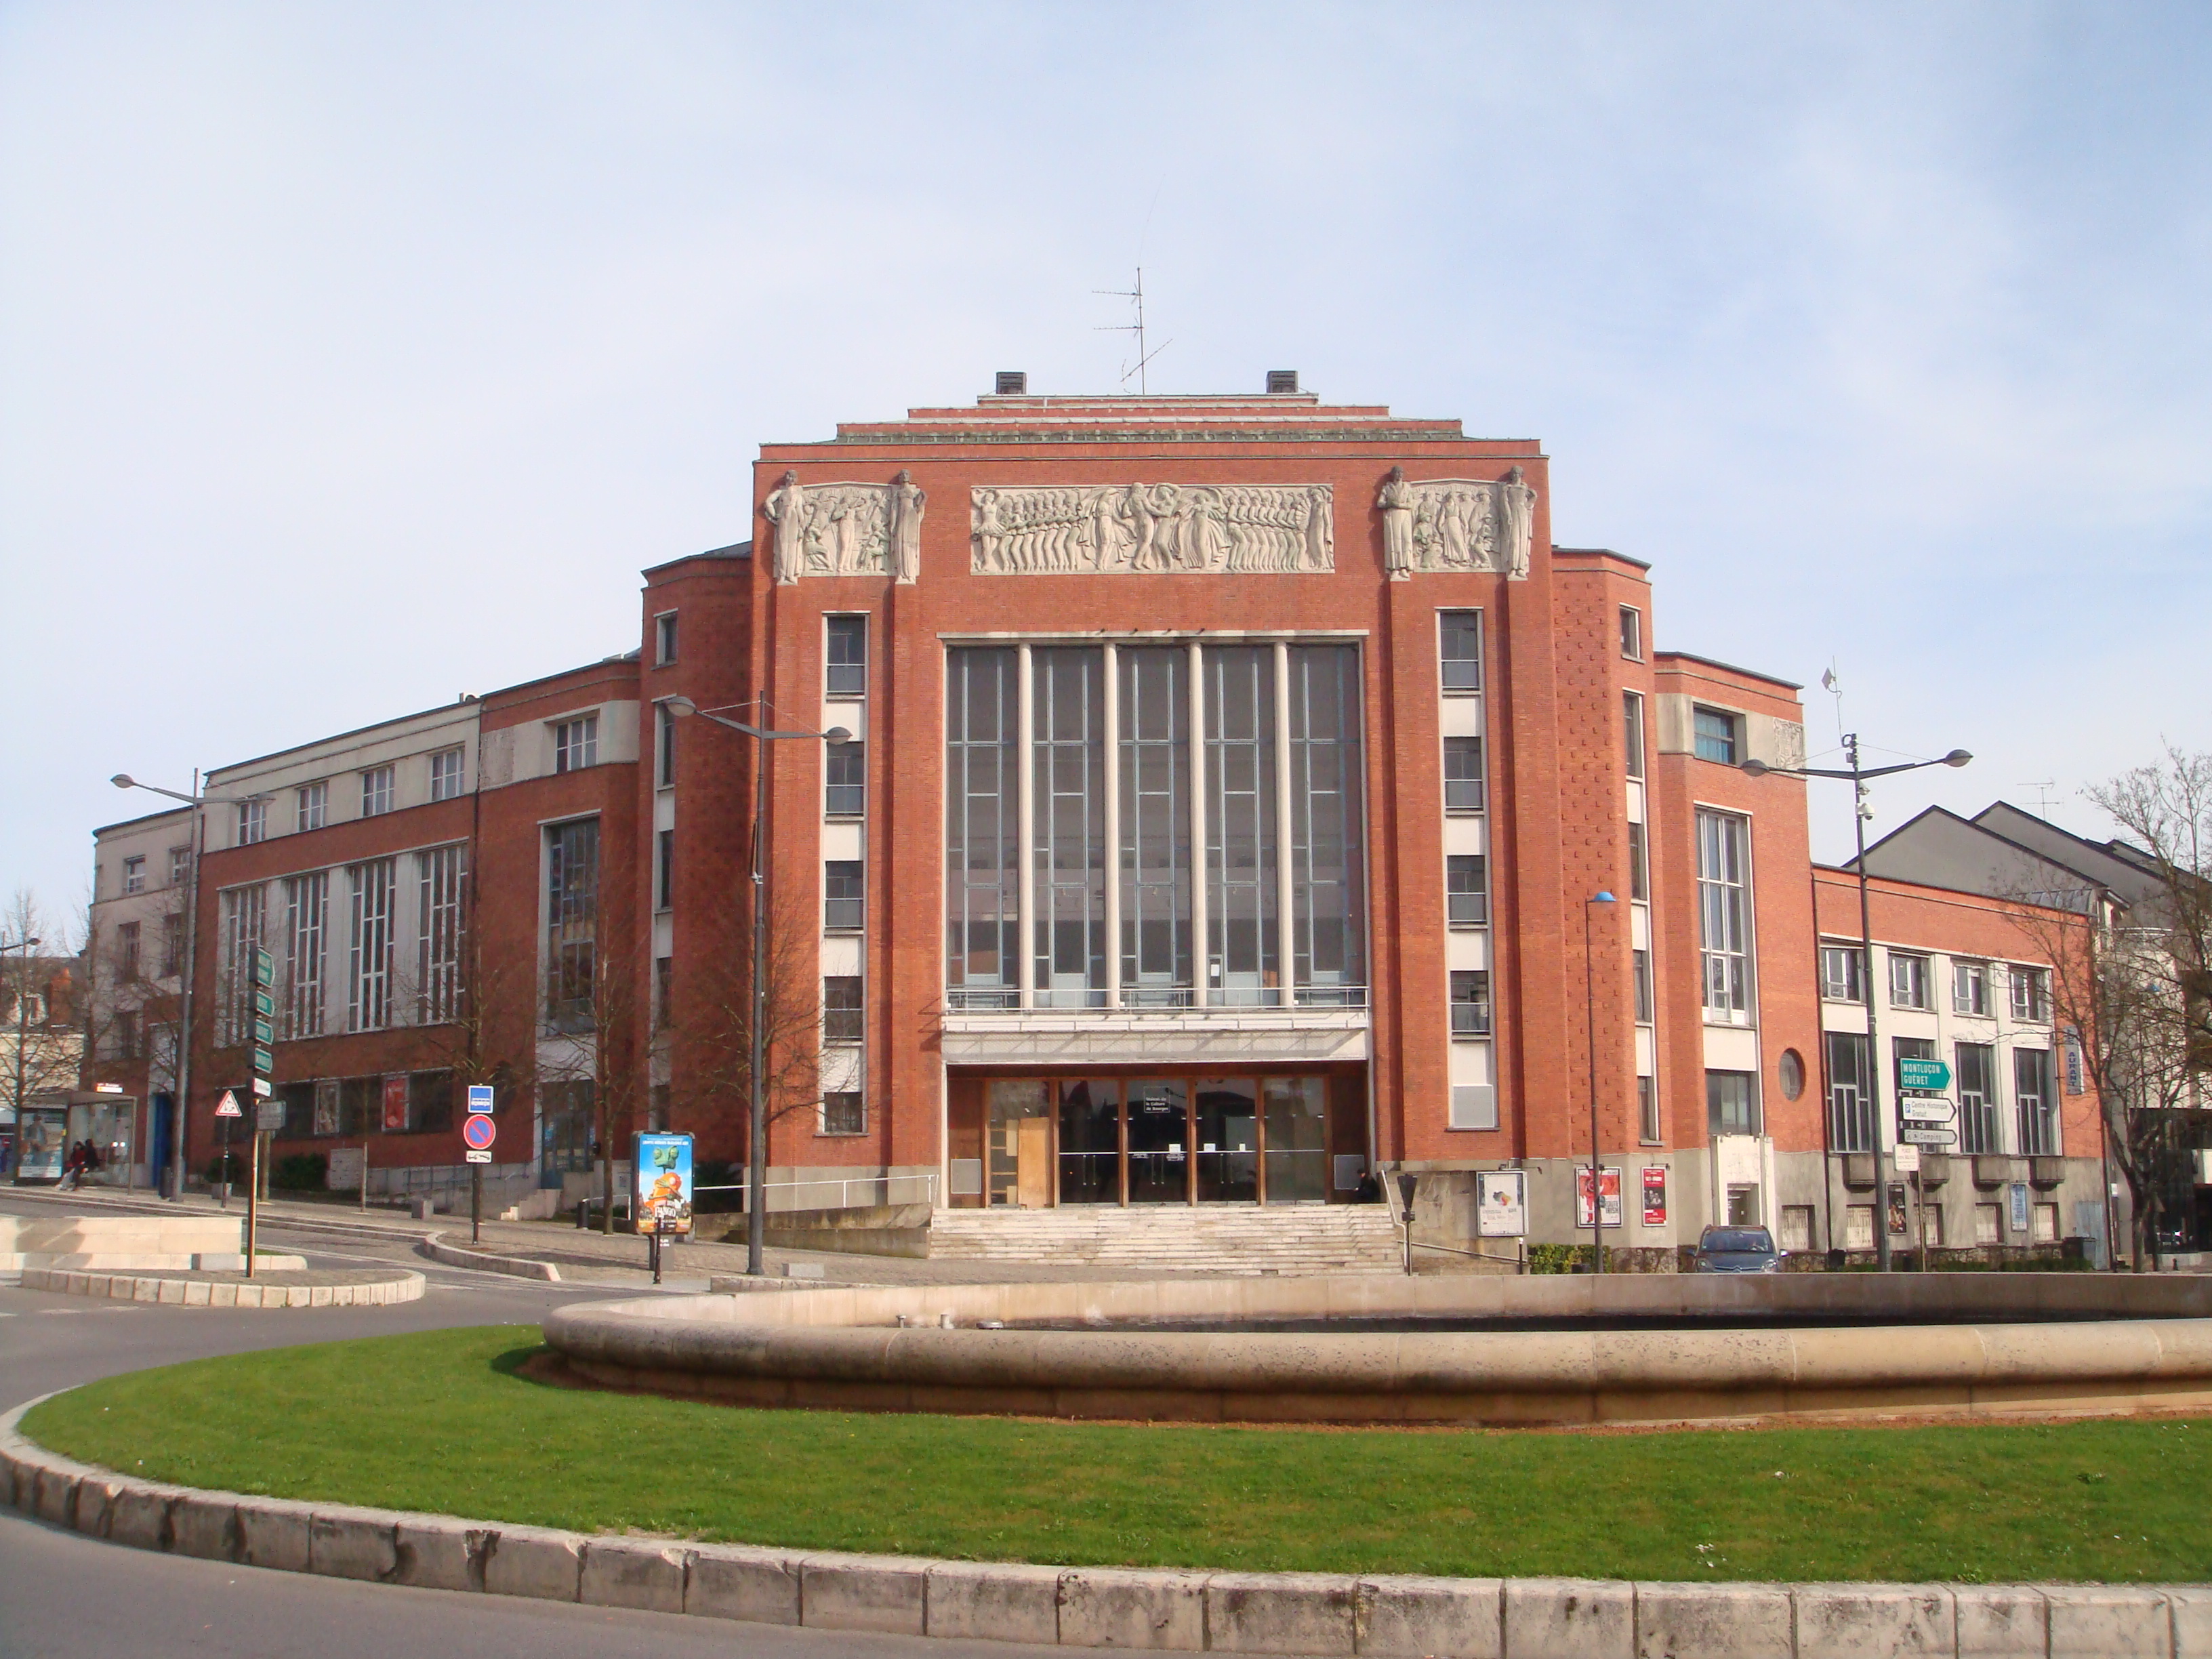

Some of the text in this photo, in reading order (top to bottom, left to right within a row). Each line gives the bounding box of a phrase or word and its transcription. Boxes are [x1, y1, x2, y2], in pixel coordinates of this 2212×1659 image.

[1903, 1063, 1941, 1074] MONTLUÇON
[1904, 1073, 1929, 1085] GUÉRET
[1926, 1102, 1948, 1111] Historique
[1920, 1132, 1942, 1142] Camping
